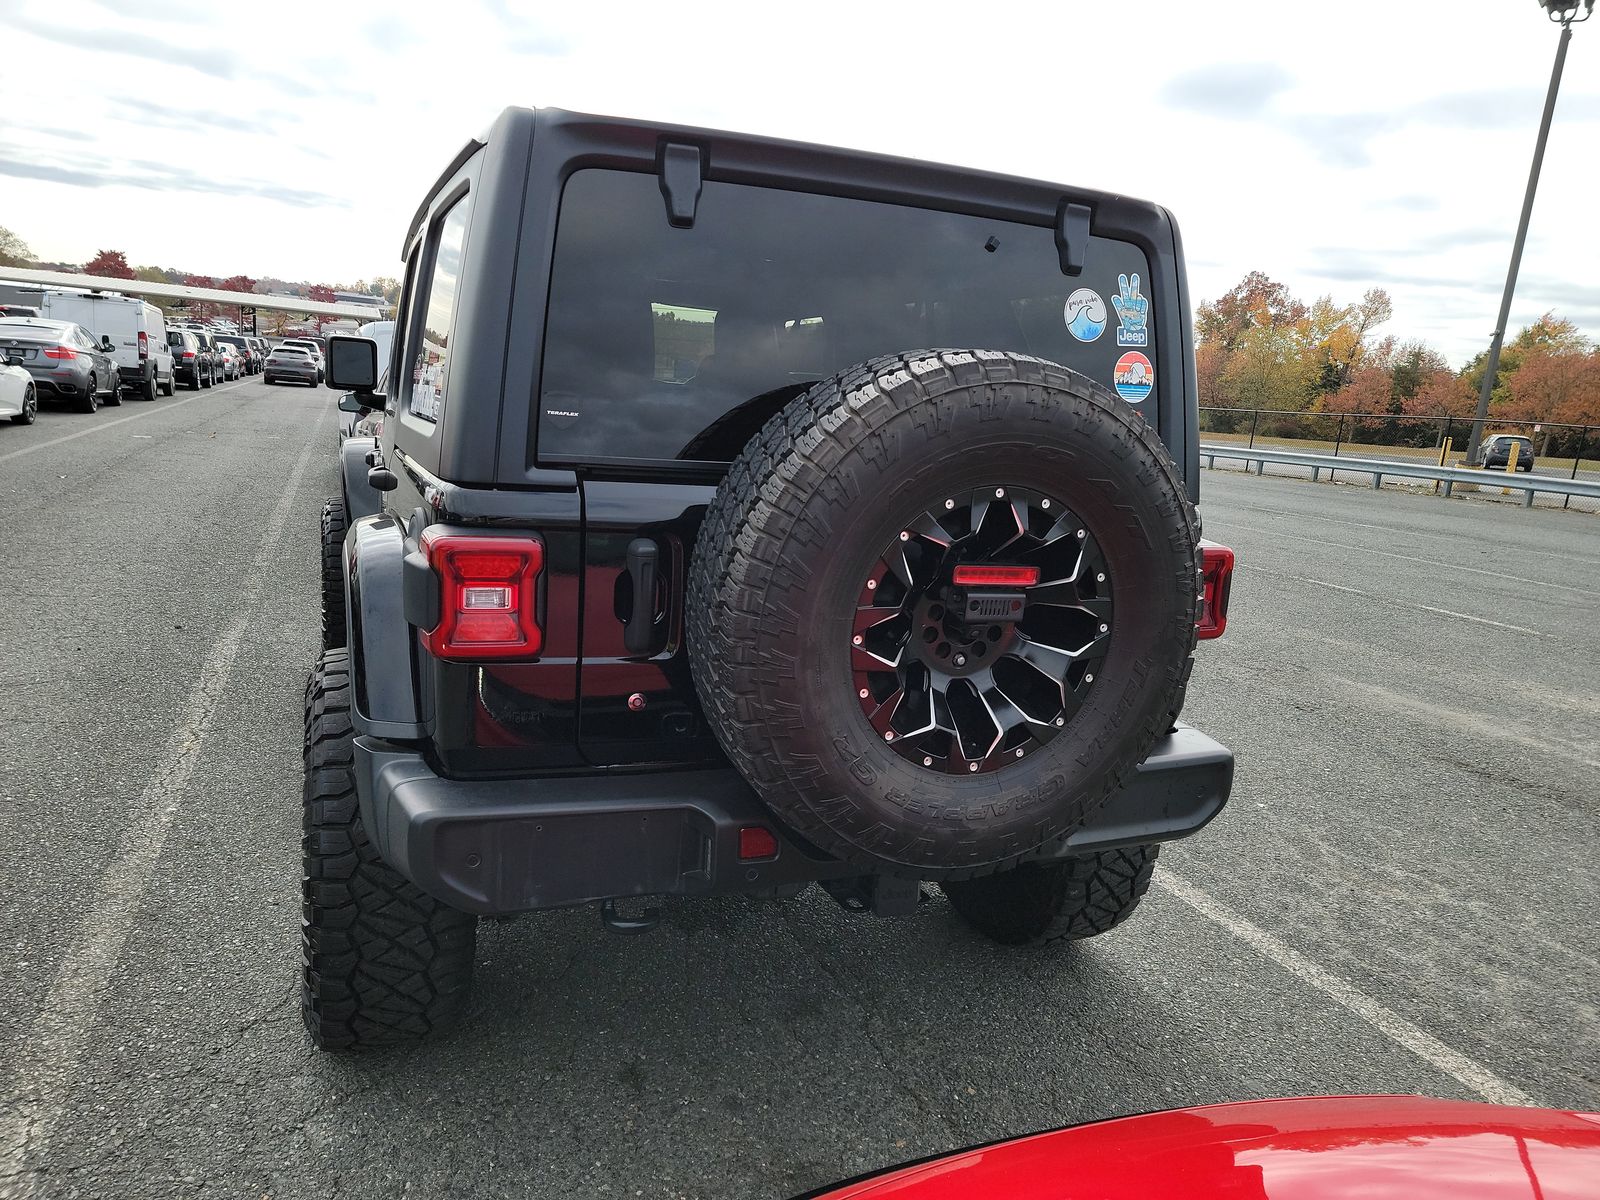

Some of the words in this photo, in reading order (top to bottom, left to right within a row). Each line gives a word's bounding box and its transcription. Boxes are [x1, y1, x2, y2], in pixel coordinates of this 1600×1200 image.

[1120, 329, 1145, 343] Jeep
[831, 736, 879, 787] G2
[884, 774, 1066, 822] GRAPPLER
